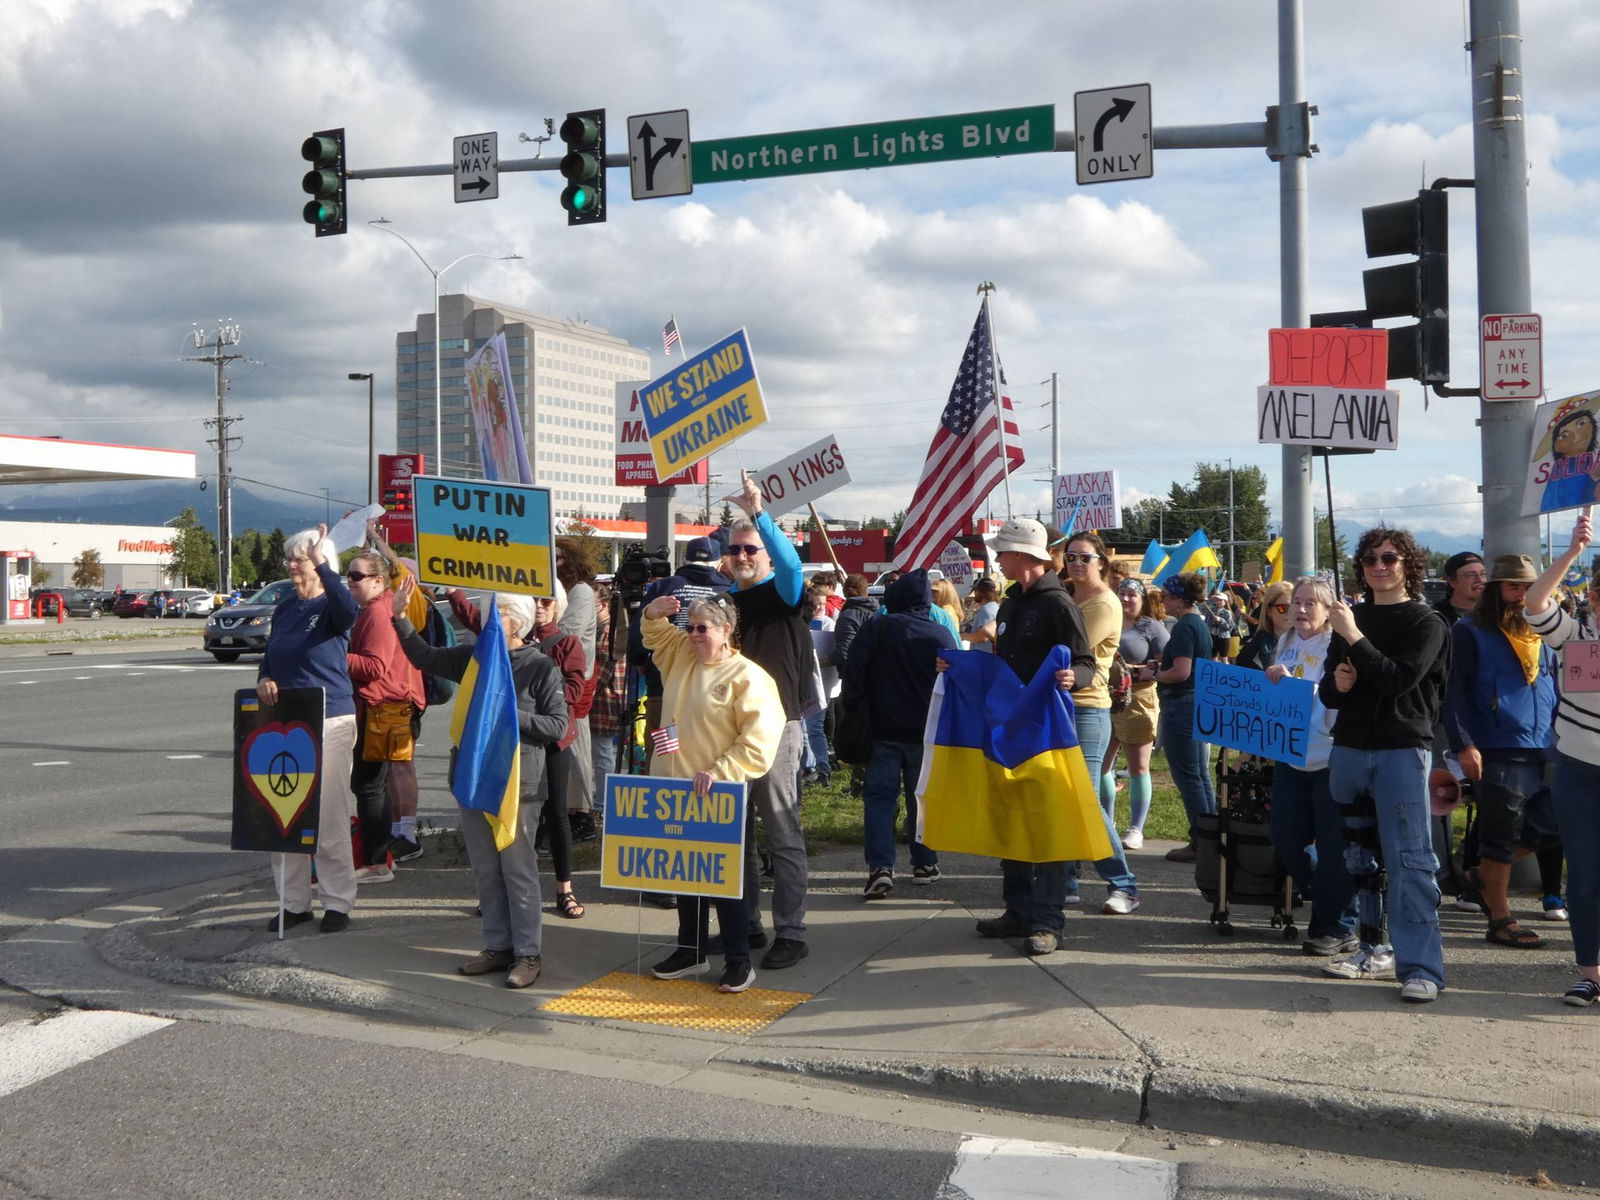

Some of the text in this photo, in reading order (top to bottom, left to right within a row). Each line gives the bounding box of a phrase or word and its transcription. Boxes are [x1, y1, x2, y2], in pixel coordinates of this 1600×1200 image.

[461, 138, 490, 156] ONE
[711, 119, 1031, 172] Northern Lights Blvd
[460, 155, 492, 174] WAY
[1087, 152, 1142, 175] ONLY
[1484, 320, 1538, 337] NO PARKING
[1270, 331, 1385, 385] DEPORT
[1498, 348, 1526, 360] ANY
[645, 342, 744, 419] WE STAND
[1496, 362, 1529, 375] TIME
[690, 392, 708, 408] WITH
[1259, 389, 1394, 443] MELANIA
[662, 393, 753, 465] UKRAINE
[616, 461, 634, 470] FOOD
[625, 470, 654, 480] APPAREL
[787, 443, 845, 491] KINGS
[1057, 471, 1113, 496] ALASKA
[433, 484, 526, 518] PUTIN
[1090, 493, 1113, 506] WITH
[117, 539, 143, 552] Fred
[452, 523, 510, 548] WAR
[428, 556, 544, 588] CRIMINAL
[1201, 686, 1262, 712] Stands
[614, 786, 736, 825] WE STAND
[663, 823, 684, 836] WITH
[617, 845, 727, 885] UKRAINE
